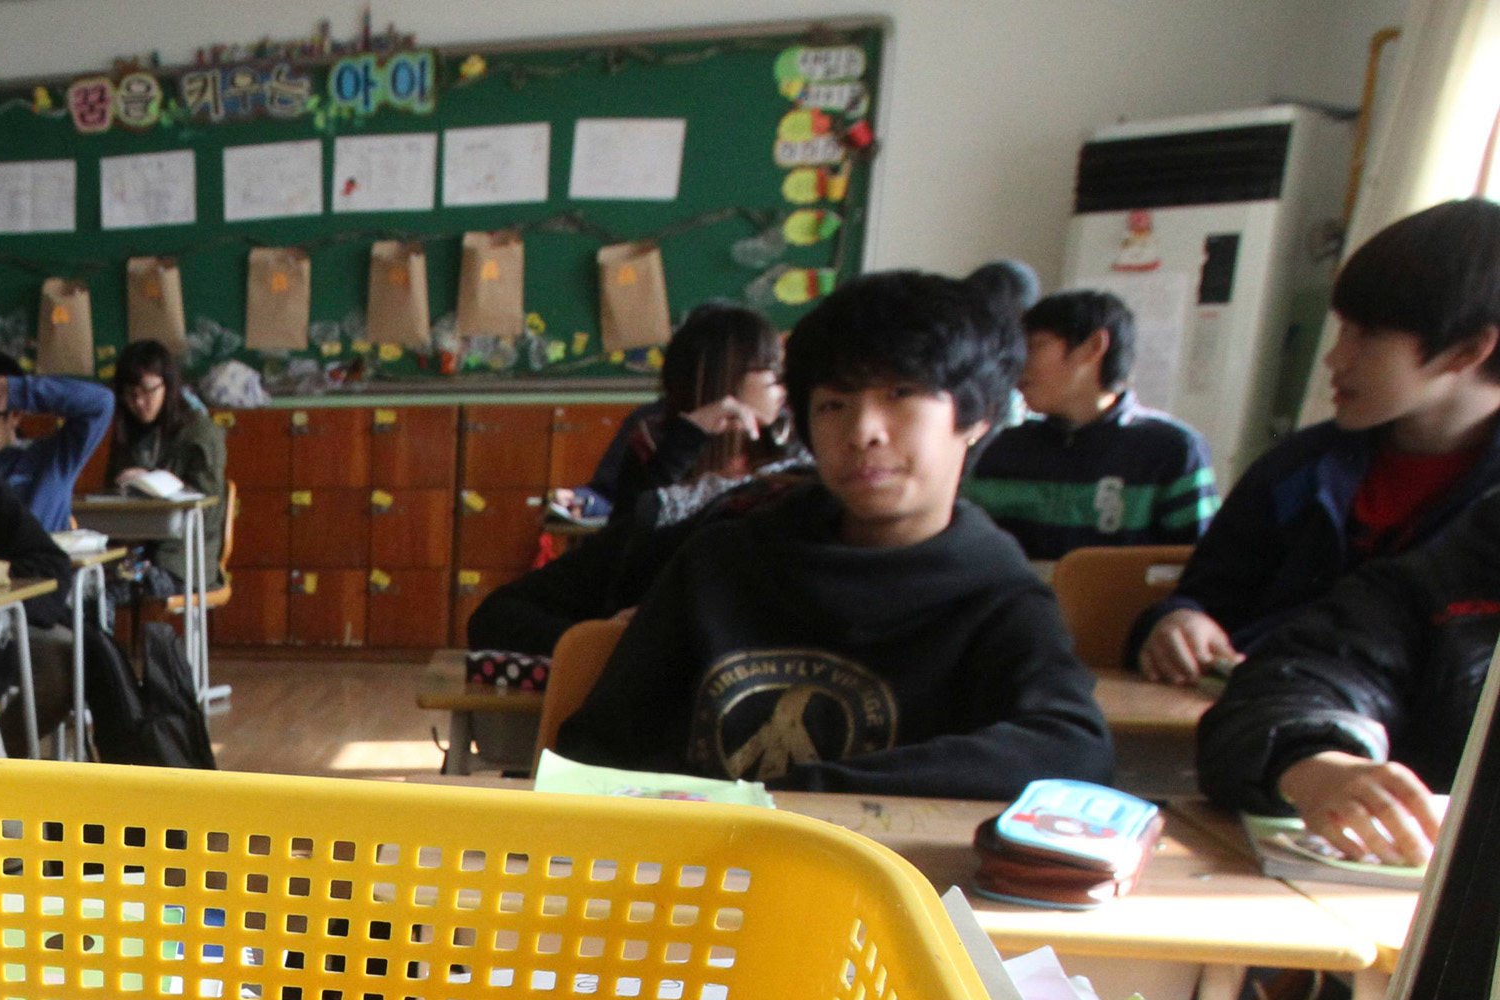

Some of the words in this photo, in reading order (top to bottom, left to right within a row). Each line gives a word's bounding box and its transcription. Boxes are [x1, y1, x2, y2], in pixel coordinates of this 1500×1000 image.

[68, 73, 162, 133] 꿈을
[182, 64, 311, 121] 키우는
[329, 50, 436, 114] 아이
[784, 660, 827, 677] FLY
